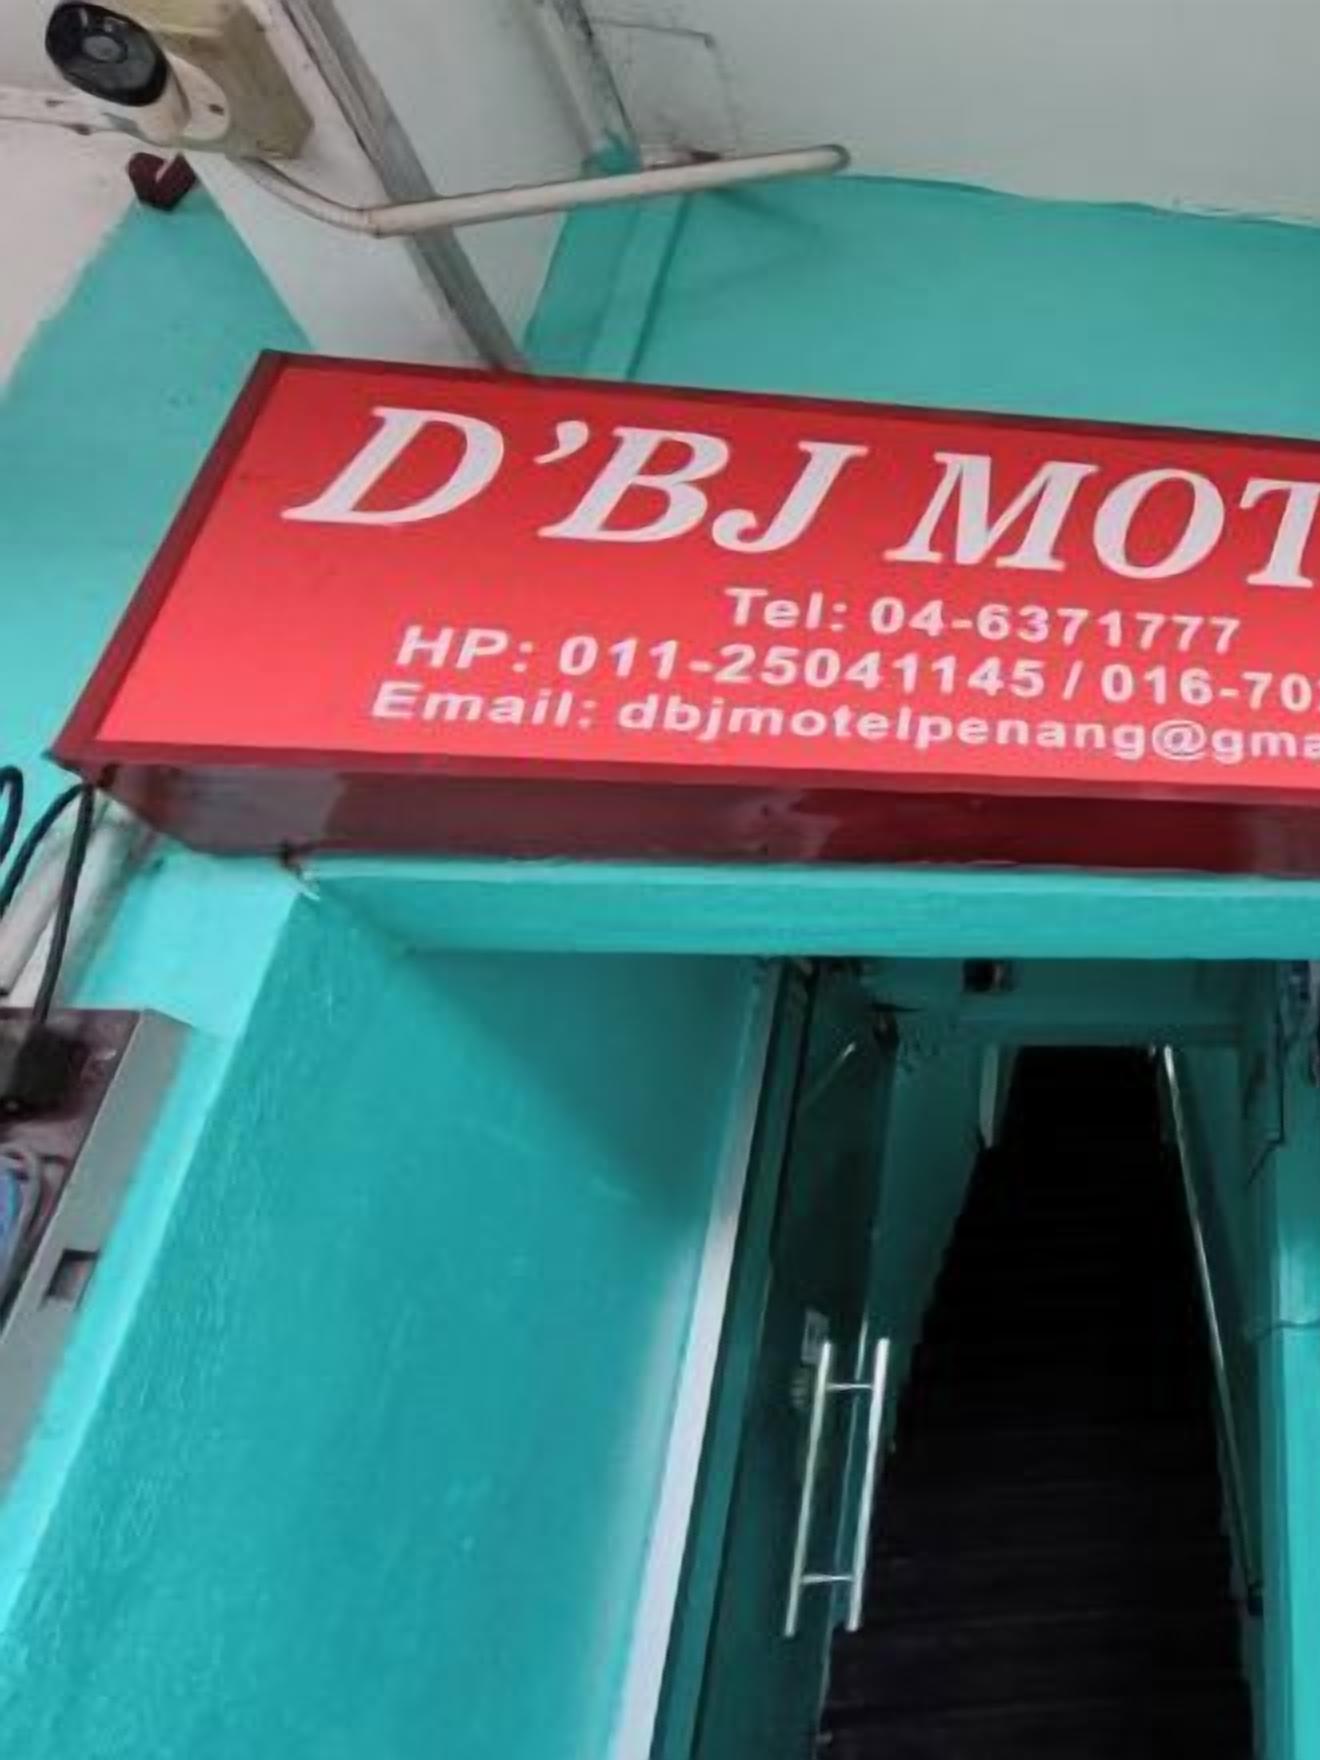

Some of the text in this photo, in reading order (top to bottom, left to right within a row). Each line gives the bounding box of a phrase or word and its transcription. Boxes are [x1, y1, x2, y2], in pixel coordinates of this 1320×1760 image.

[282, 407, 866, 554] D'BJ
[726, 587, 1241, 653] Tel: 04-6371777
[395, 625, 533, 673] HP:
[557, 635, 1047, 699] 011-25041145
[1063, 662, 1083, 701] /
[371, 680, 596, 728] Email:
